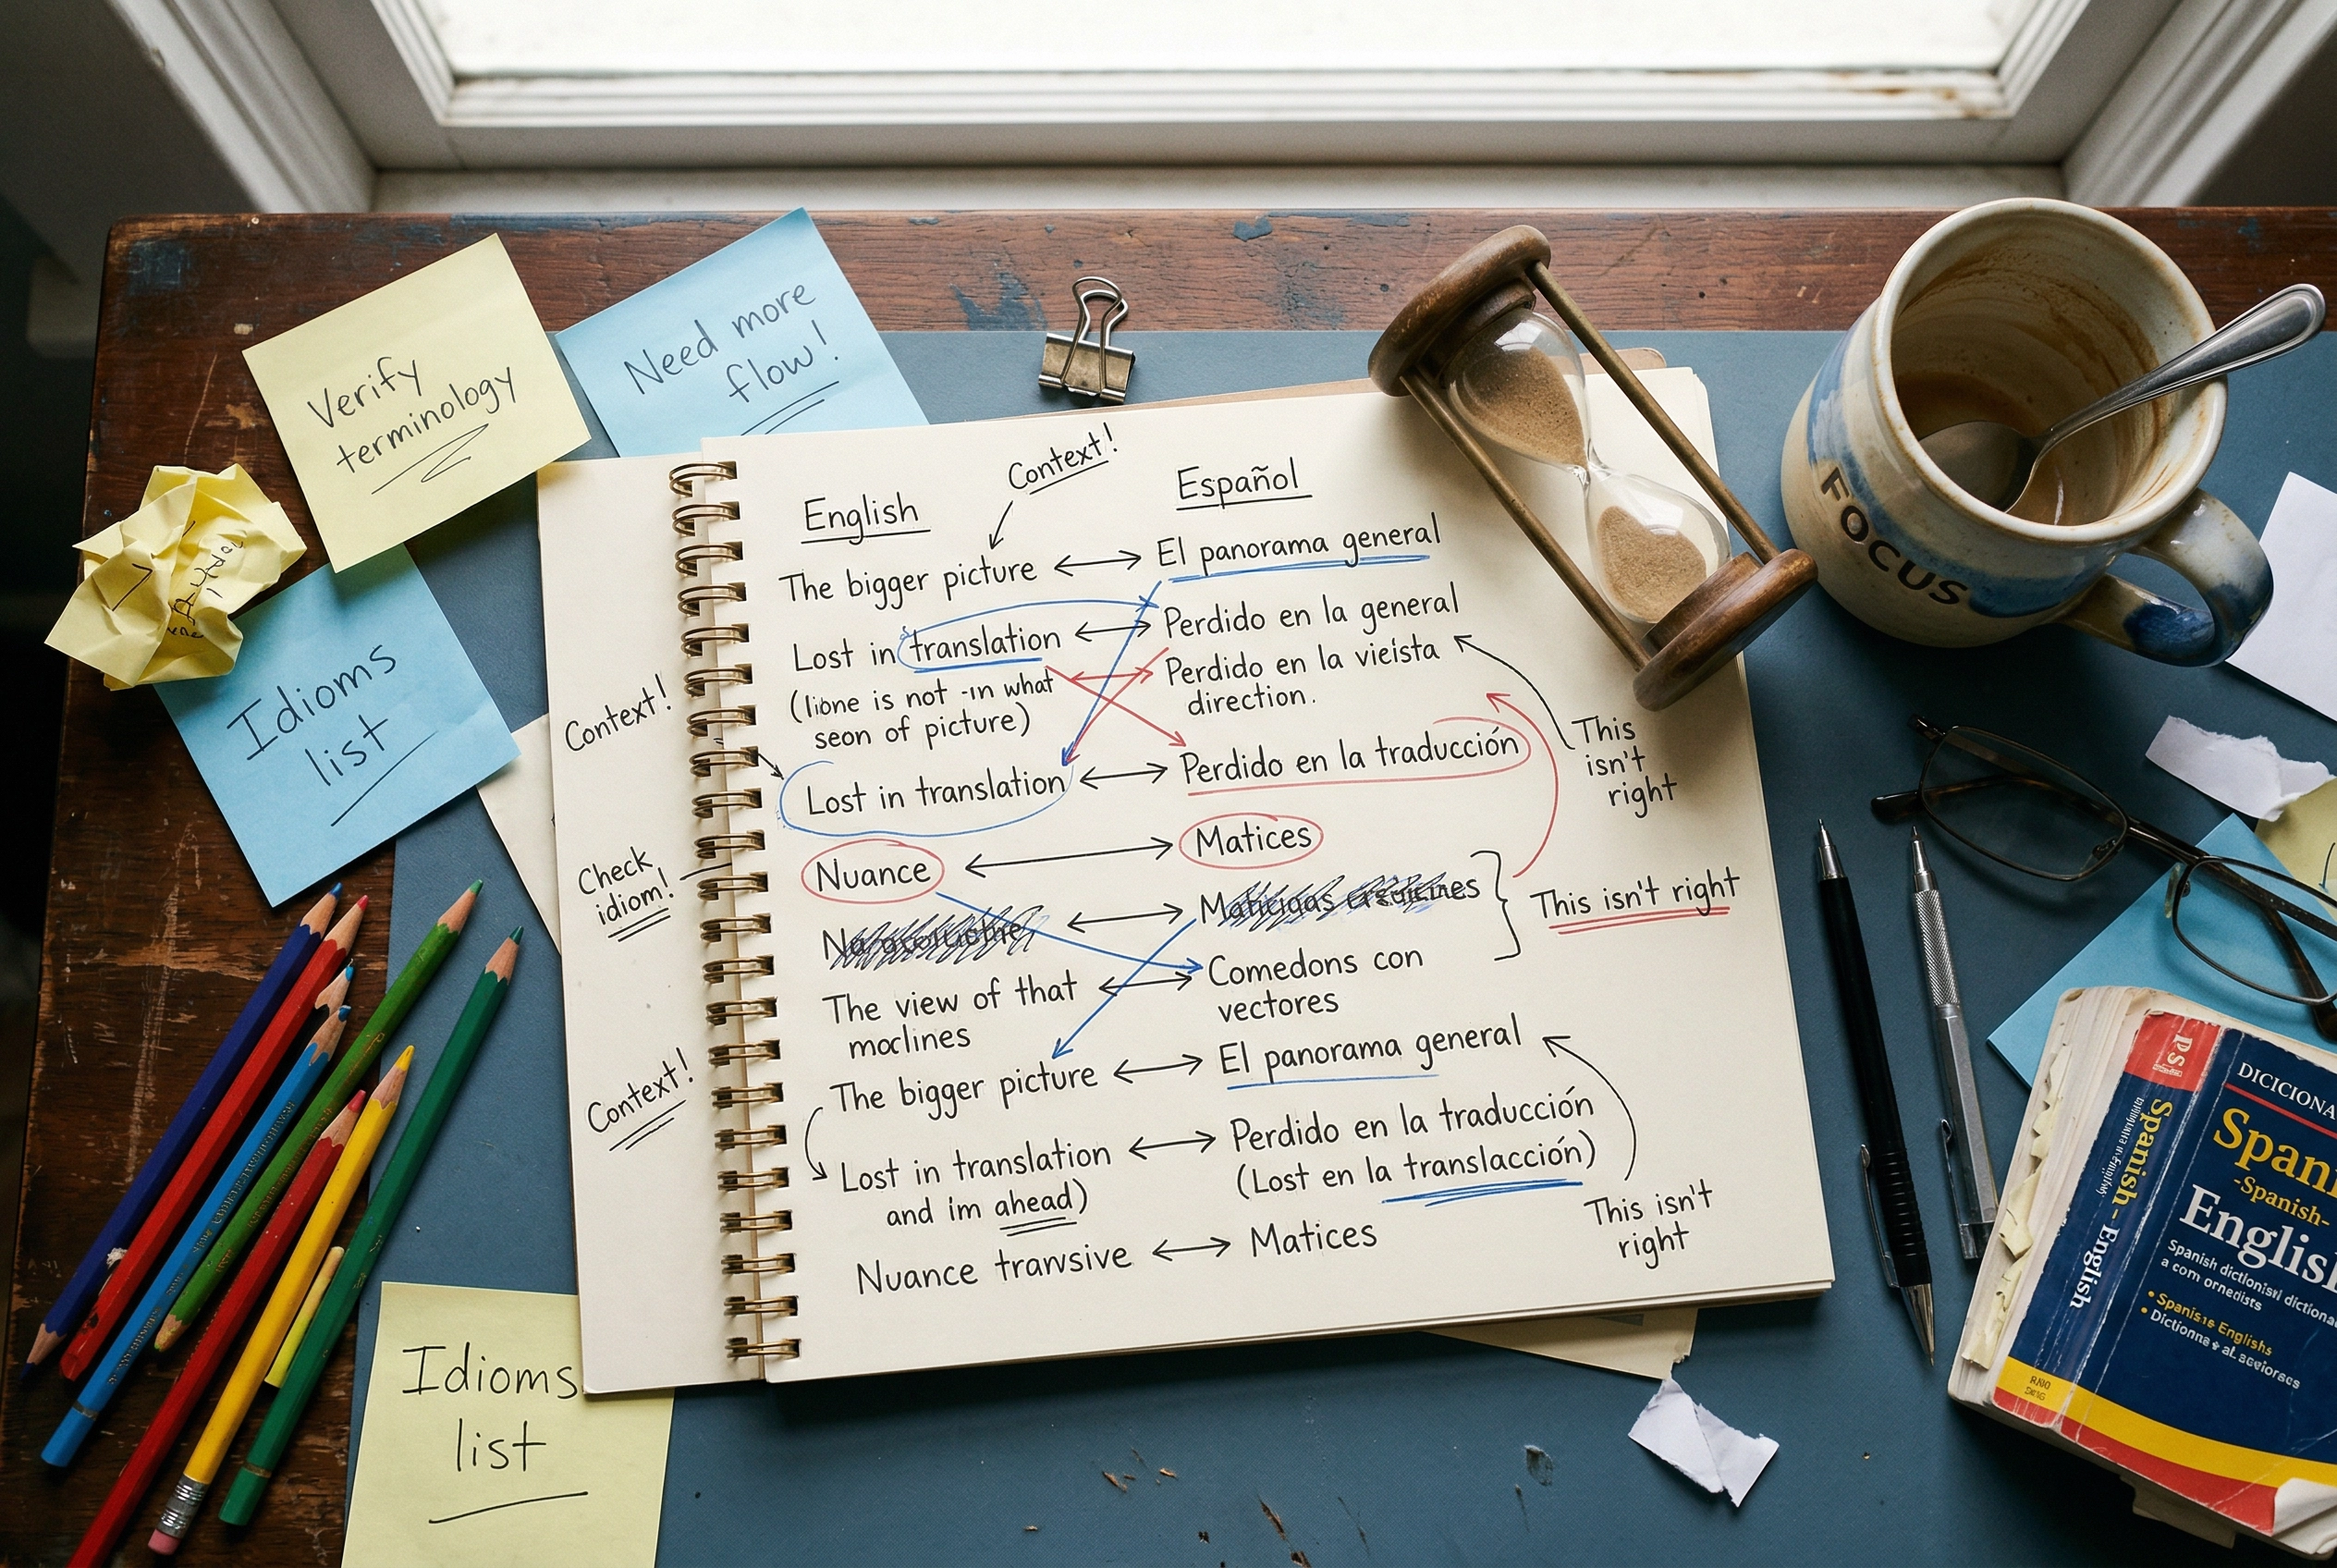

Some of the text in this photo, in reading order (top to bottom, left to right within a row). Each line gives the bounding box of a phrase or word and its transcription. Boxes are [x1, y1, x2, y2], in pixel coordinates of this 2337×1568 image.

[624, 284, 816, 395] Need more
[726, 320, 839, 403] flow!
[308, 357, 424, 429] Verify
[336, 366, 517, 472] terminology
[1009, 422, 1118, 490] Context!
[1177, 457, 1300, 509] Español
[804, 492, 919, 545] English
[1156, 511, 1441, 577] El panorama general
[1821, 466, 1969, 606] FOCUS
[778, 555, 1038, 610] The bigger picture
[1165, 581, 1460, 639] Perdido en la general
[793, 622, 1061, 671] Lost in translation
[1165, 651, 1264, 686] Perdido
[1277, 654, 1306, 675] en
[1318, 643, 1344, 671] la
[226, 644, 396, 760] Idioms
[565, 674, 673, 753] Context!
[873, 690, 894, 711] is
[906, 678, 948, 708] not
[1004, 668, 1054, 698] what
[1188, 682, 1316, 717] direction.
[305, 714, 388, 786] list
[814, 701, 1031, 751] seon of picture)
[1572, 716, 1635, 743] This
[1180, 726, 1520, 785] Perdido en la traducción
[1585, 745, 1646, 777] isn't
[806, 766, 1066, 815] Lost in translation
[1609, 772, 1678, 819] right
[1196, 821, 1313, 858] Matices
[577, 845, 654, 896] Check
[595, 867, 674, 925] idiom!
[816, 858, 932, 893] Nuance
[1529, 866, 1741, 919] This isn't right
[1208, 947, 1424, 987] Comedons con
[822, 969, 1078, 1024] The view of that
[1217, 989, 1340, 1023] vectores
[1218, 1012, 1523, 1084] El panorama general
[586, 1047, 694, 1134] Context!
[829, 1060, 1098, 1121] The bigger picture
[1230, 1085, 1595, 1153] Perdido en la traducción
[842, 1138, 1111, 1193] Lost in translation
[1237, 1129, 1597, 1200] (Lost en la translacción)
[2111, 1097, 2173, 1207] Spanish
[887, 1178, 1088, 1227] and im ahead)
[1584, 1179, 1713, 1225] This isn't
[1251, 1220, 1377, 1257] Matices
[1619, 1220, 1690, 1270] right
[2070, 1222, 2121, 1309] English
[2168, 1239, 2218, 1271] Spanish
[856, 1260, 979, 1295] Nuance
[402, 1341, 579, 1399] Idioms
[457, 1418, 546, 1472] list
